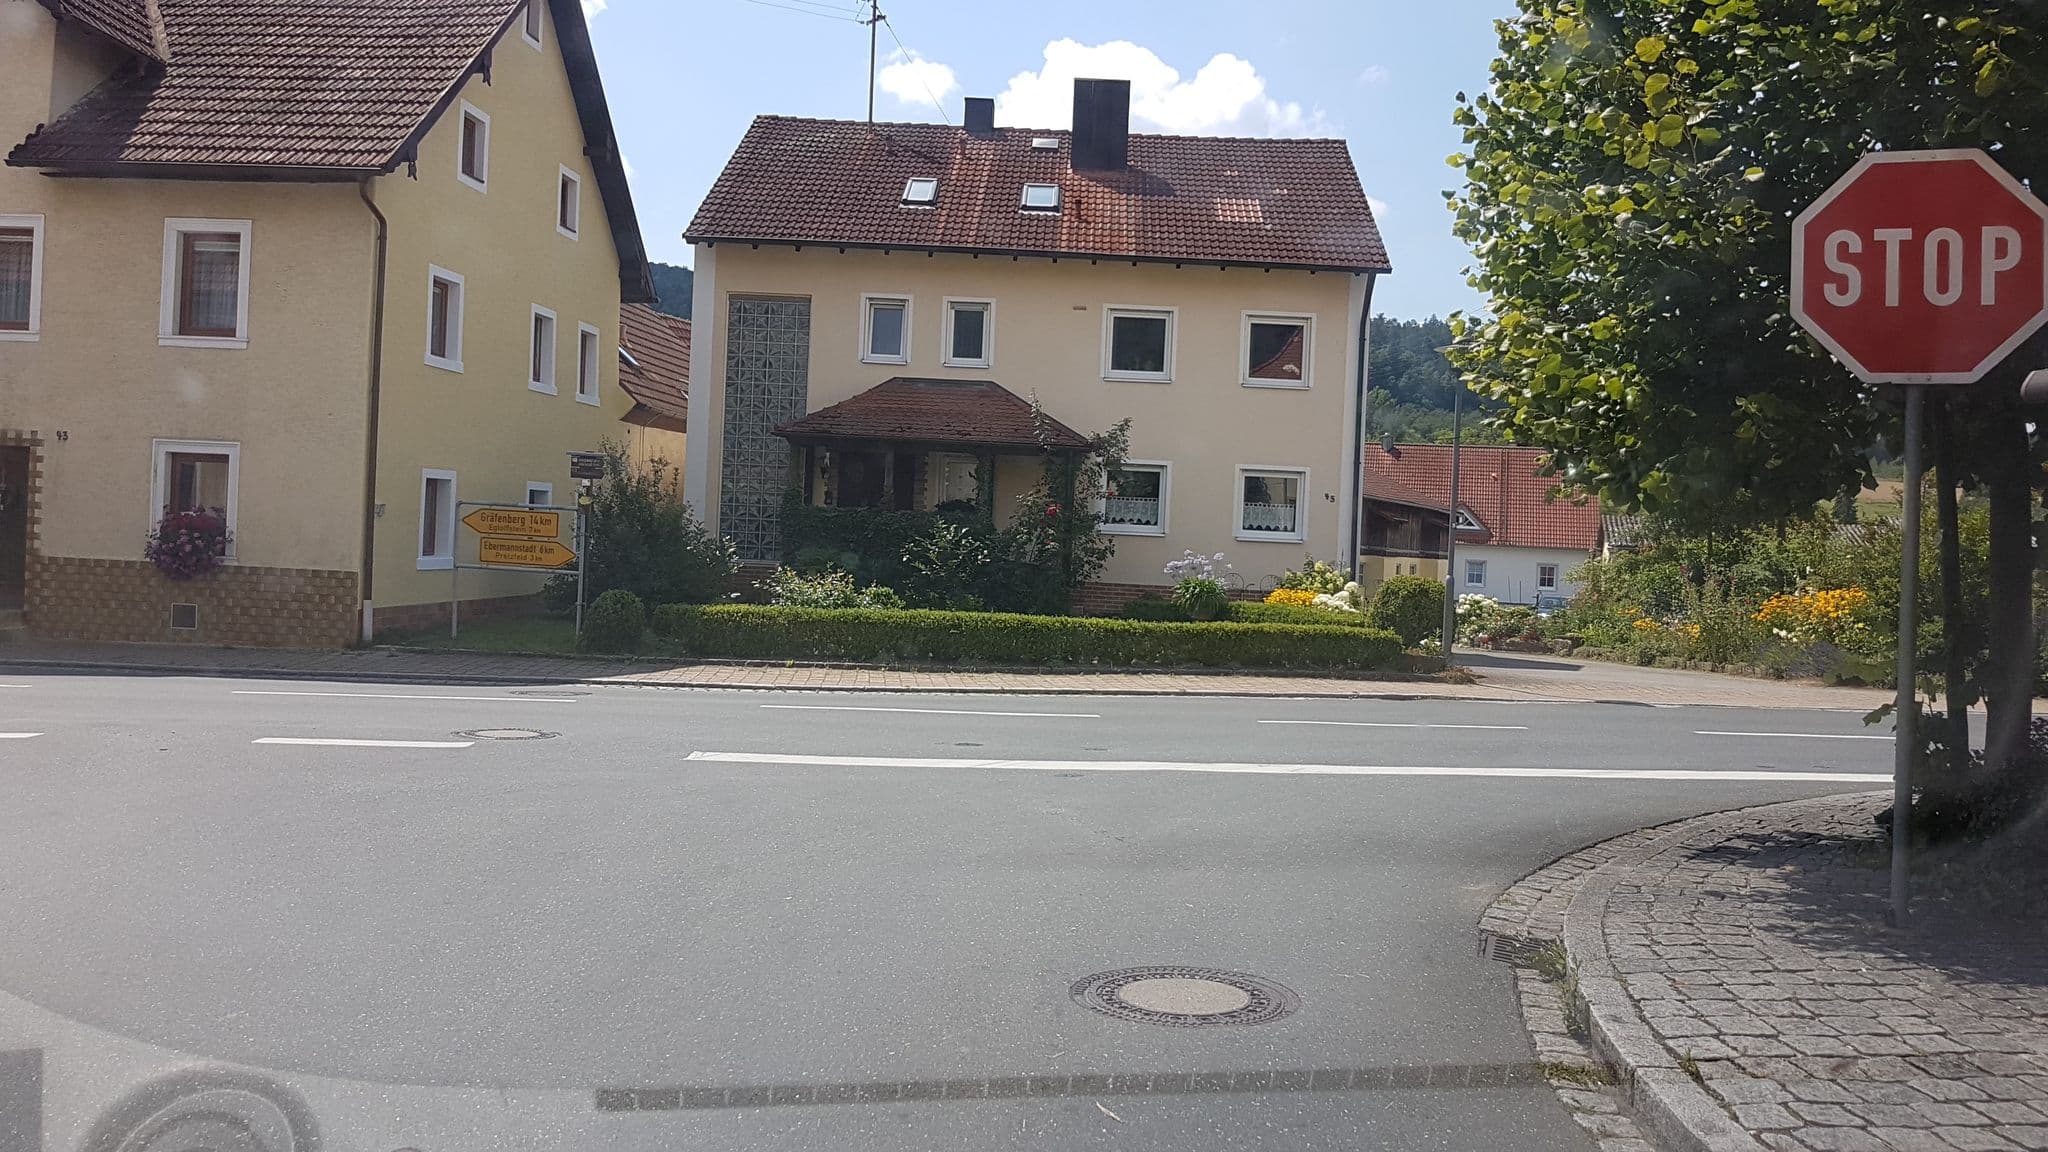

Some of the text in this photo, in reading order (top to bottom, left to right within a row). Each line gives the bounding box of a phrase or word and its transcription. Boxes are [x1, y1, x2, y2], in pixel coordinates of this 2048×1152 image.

[1823, 226, 2022, 307] STOP
[480, 511, 552, 526] Gräfenberg 14 km
[483, 540, 537, 554] Ebermannstadt
[544, 546, 555, 555] km
